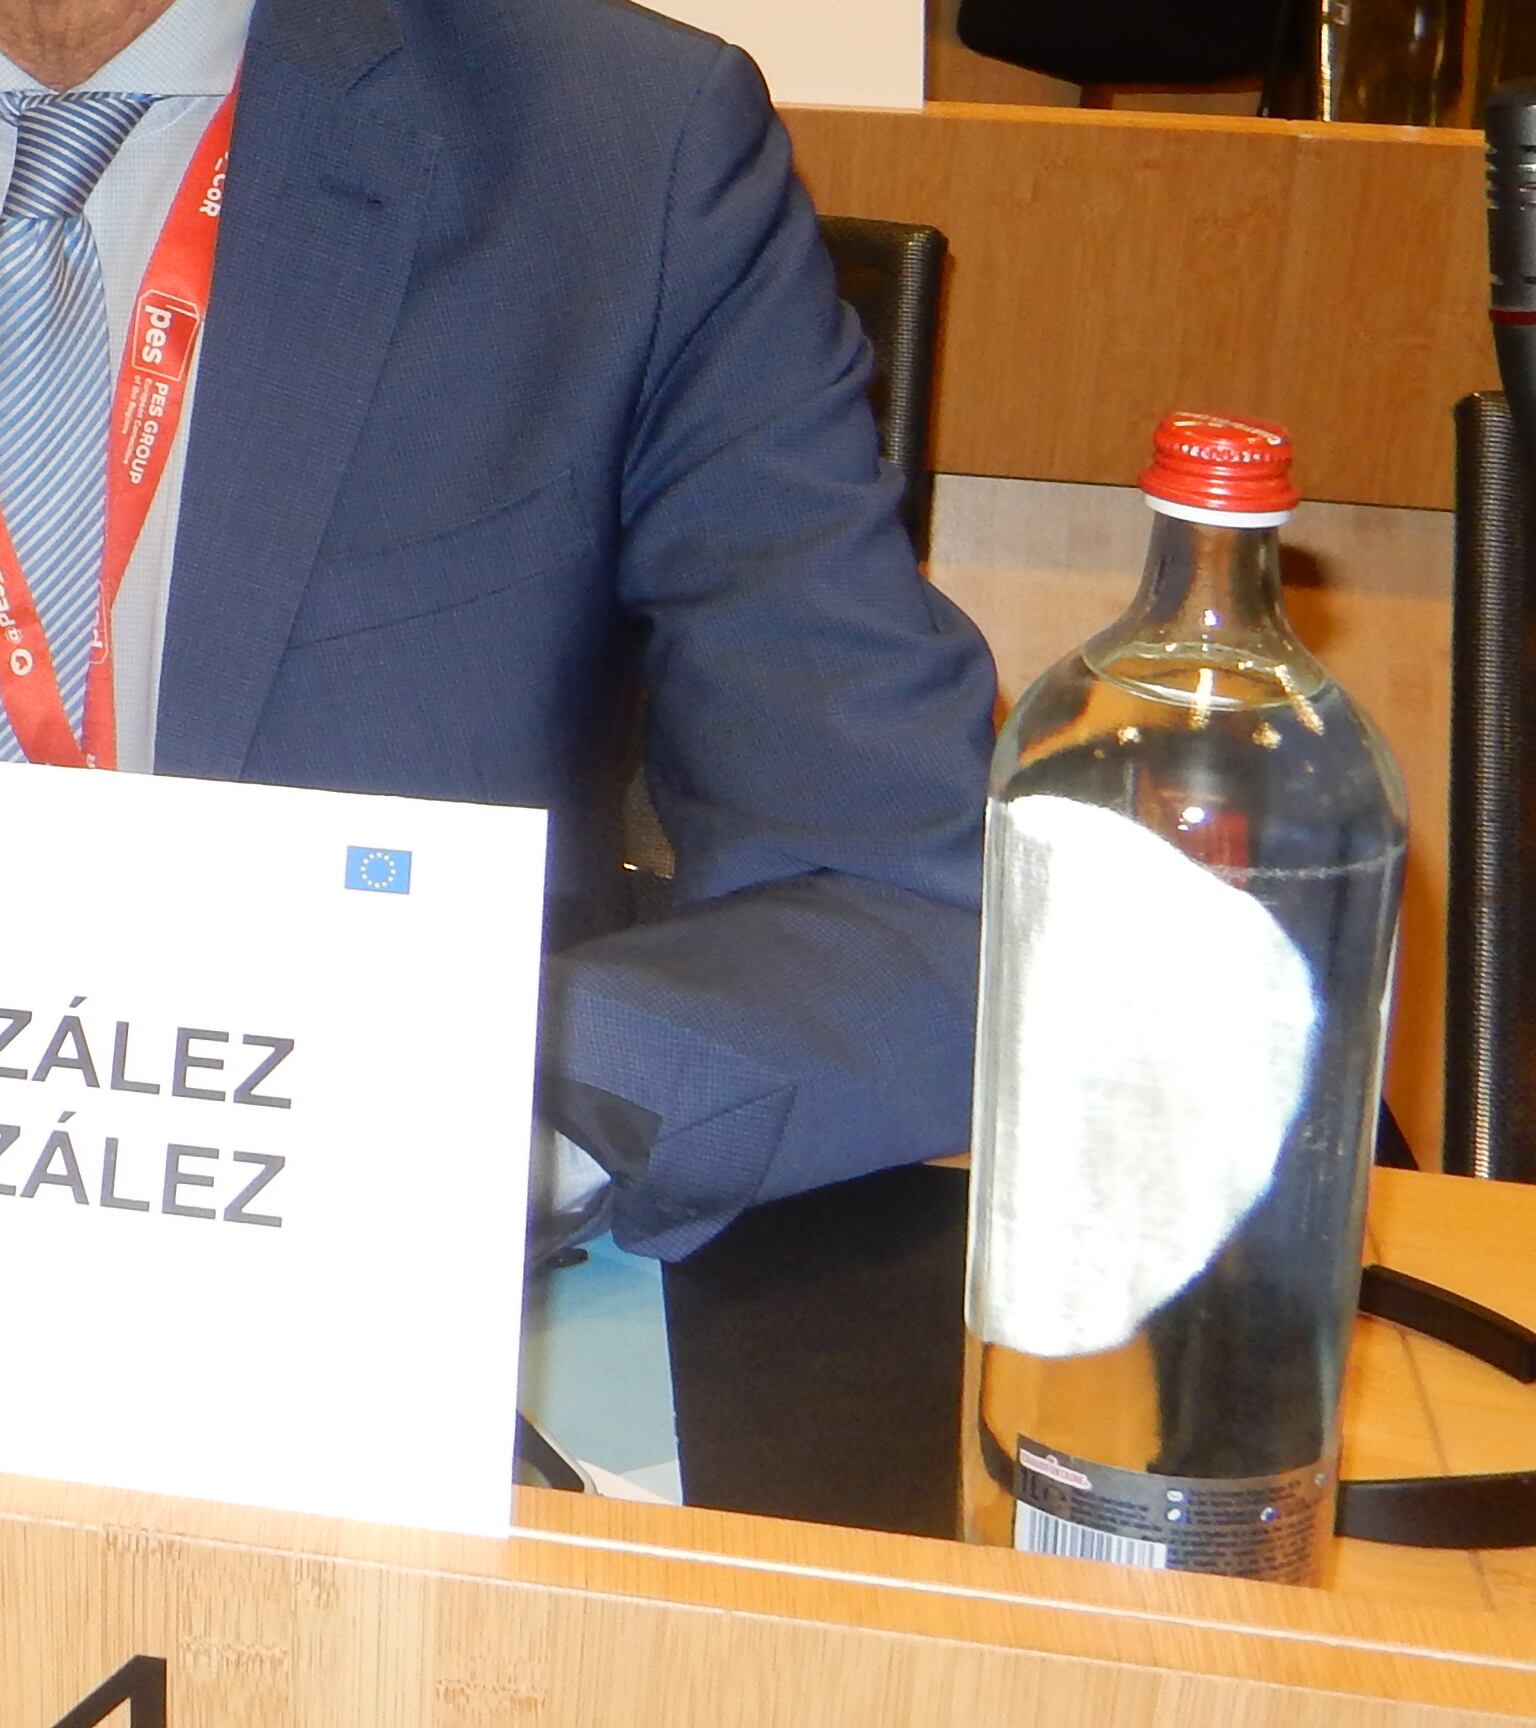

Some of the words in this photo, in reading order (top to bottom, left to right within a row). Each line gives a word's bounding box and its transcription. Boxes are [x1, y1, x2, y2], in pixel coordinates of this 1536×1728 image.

[142, 303, 172, 365] pes
[148, 382, 170, 418] PES
[129, 420, 159, 485] GROUP
